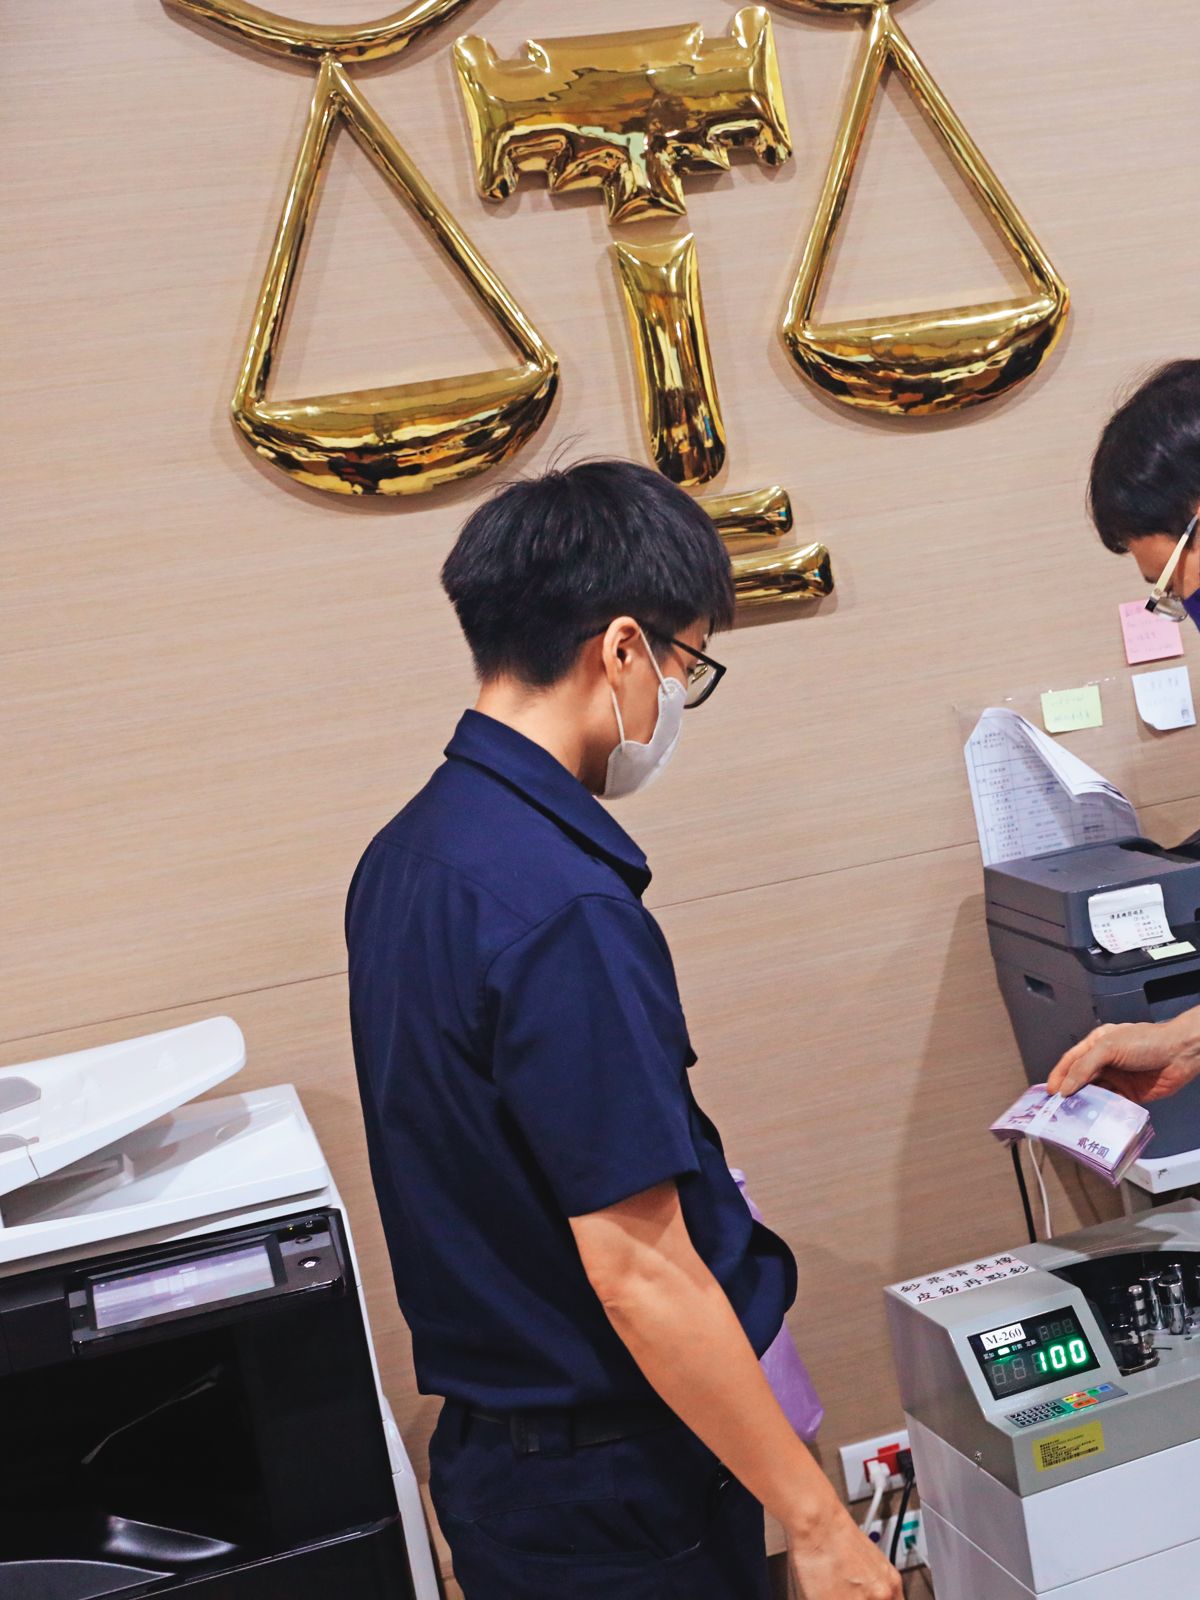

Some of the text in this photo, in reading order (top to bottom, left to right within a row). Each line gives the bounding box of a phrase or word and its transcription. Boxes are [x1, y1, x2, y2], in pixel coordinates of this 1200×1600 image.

[1076, 1136, 1110, 1157] 貳仟圓
[917, 1265, 1030, 1303] 皮筋再點鈔
[985, 1327, 1023, 1345] M-260
[1039, 1339, 1087, 1372] 100
